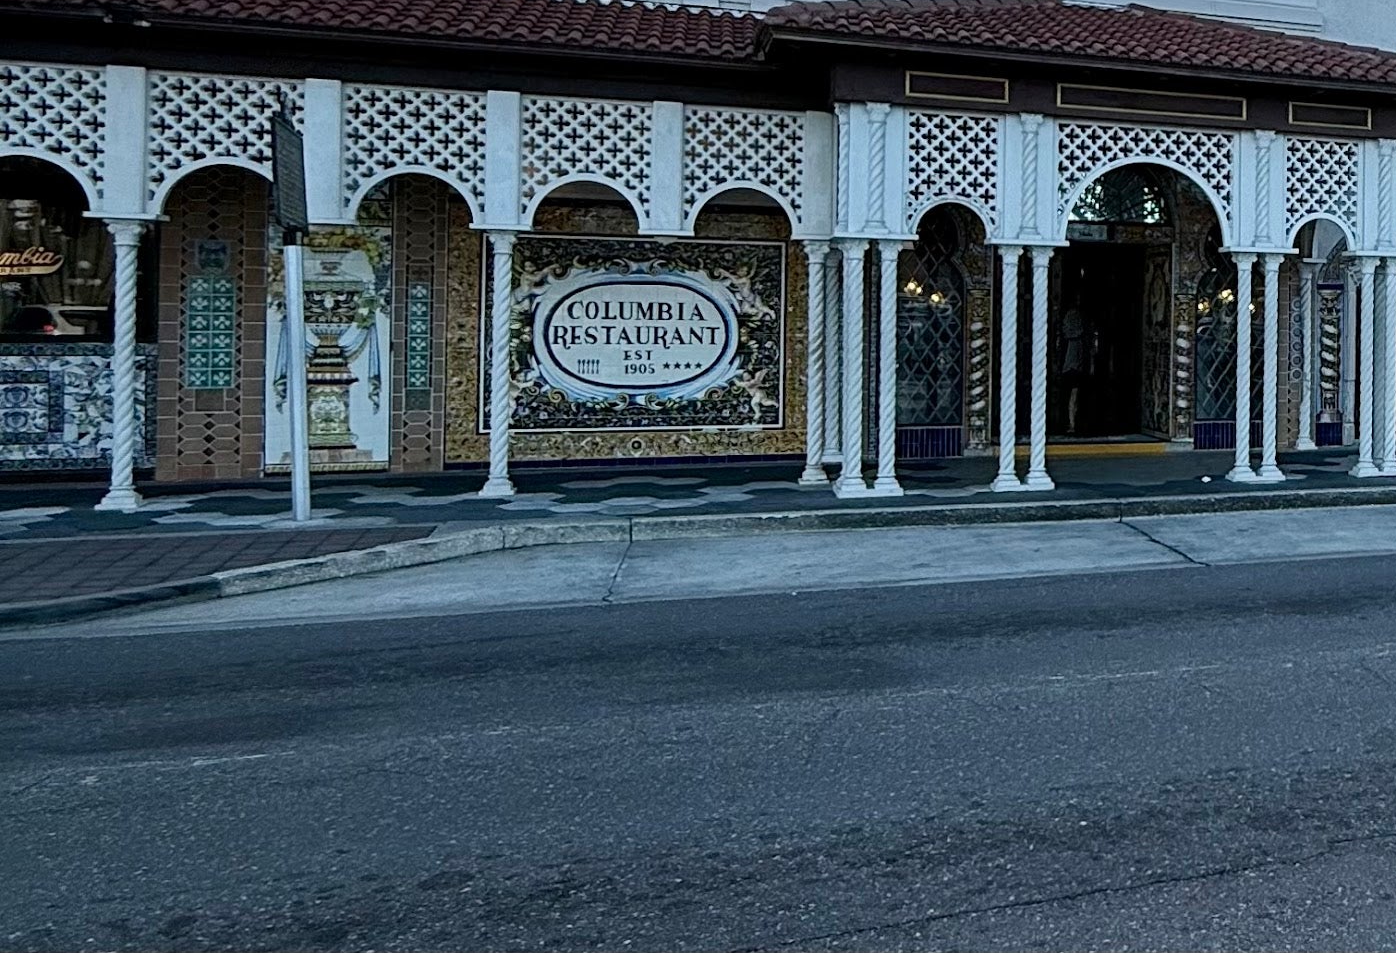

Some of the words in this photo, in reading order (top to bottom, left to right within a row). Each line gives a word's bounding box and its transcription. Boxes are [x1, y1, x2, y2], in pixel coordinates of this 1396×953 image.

[567, 300, 708, 321] COLUMBIA
[552, 325, 720, 350] RESTAURANT
[623, 350, 653, 361] EST
[624, 363, 656, 375] 1905
